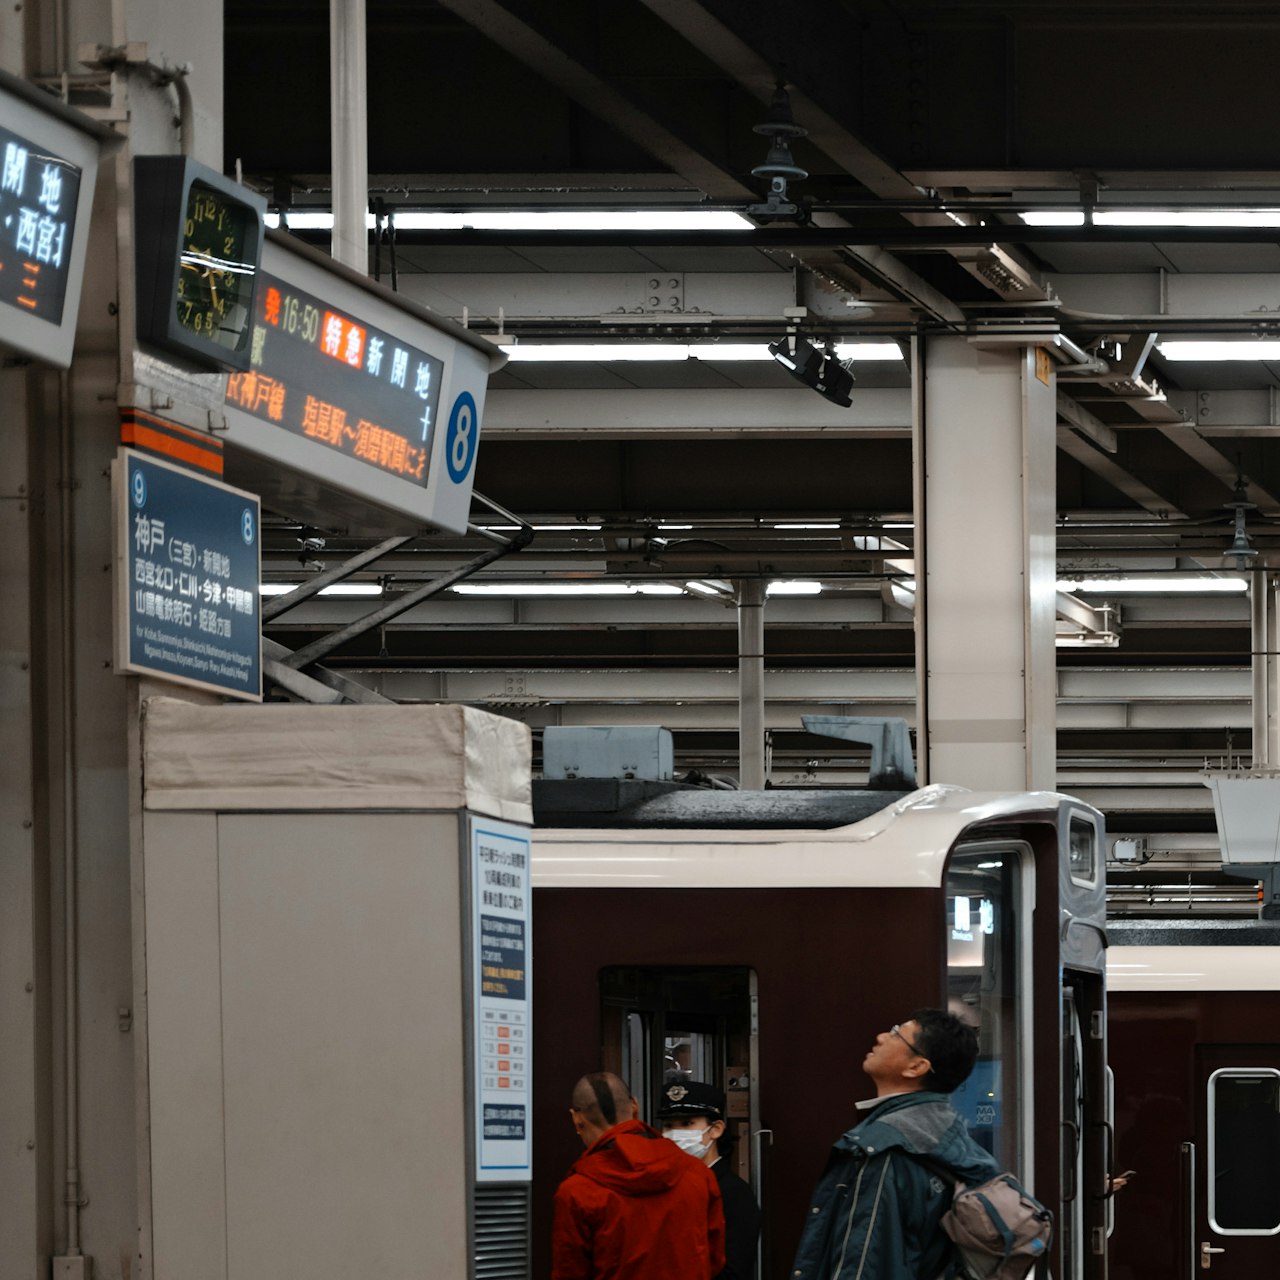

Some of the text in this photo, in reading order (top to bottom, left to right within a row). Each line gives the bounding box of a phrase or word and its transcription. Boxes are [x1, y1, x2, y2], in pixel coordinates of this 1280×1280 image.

[283, 296, 318, 343] 16:50
[325, 314, 362, 366] 特急
[452, 404, 472, 472] 8
[134, 474, 144, 504] 9
[135, 512, 164, 554] 神戸
[244, 512, 252, 544] 8
